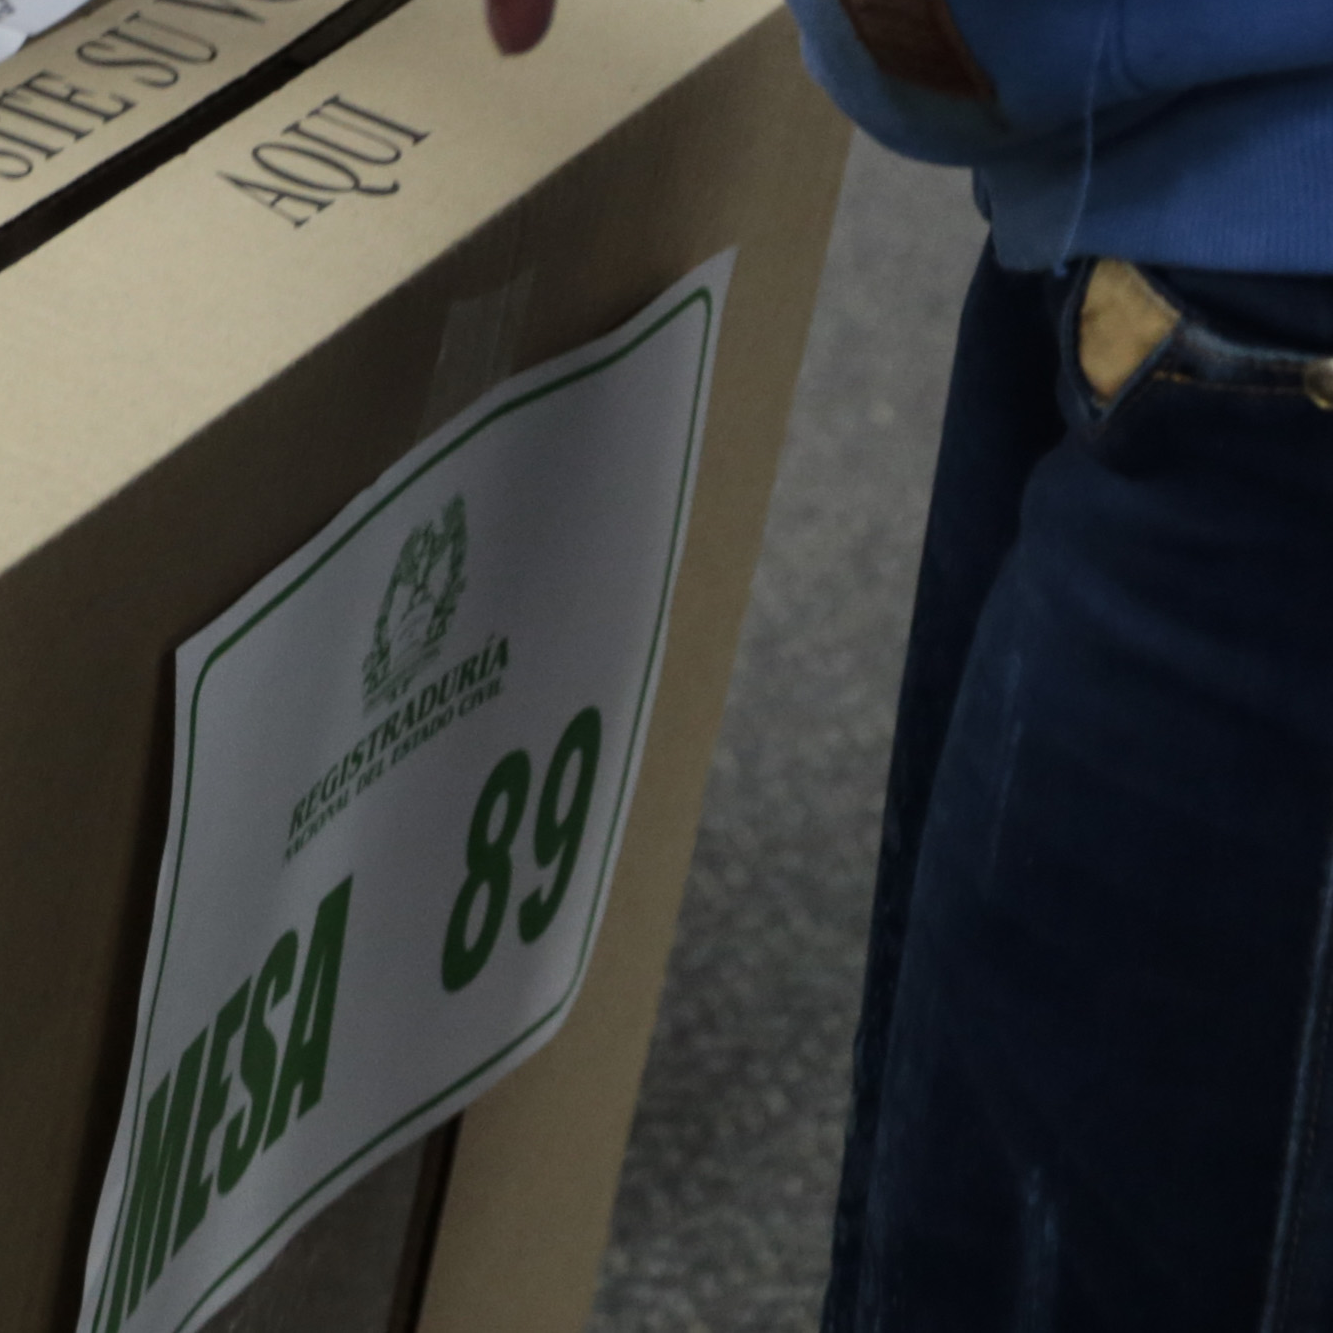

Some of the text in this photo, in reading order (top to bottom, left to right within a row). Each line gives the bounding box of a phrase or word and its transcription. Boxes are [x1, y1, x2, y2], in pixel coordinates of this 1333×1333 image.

[75, 11, 221, 92] SU
[216, 94, 432, 229] AQUI
[287, 633, 510, 843] REGISTRADURÍA
[355, 757, 384, 796] DEL
[391, 704, 455, 766] ESTADO
[458, 675, 503, 717] CIVIL
[440, 705, 602, 993] 89
[106, 874, 354, 1333] MESA
